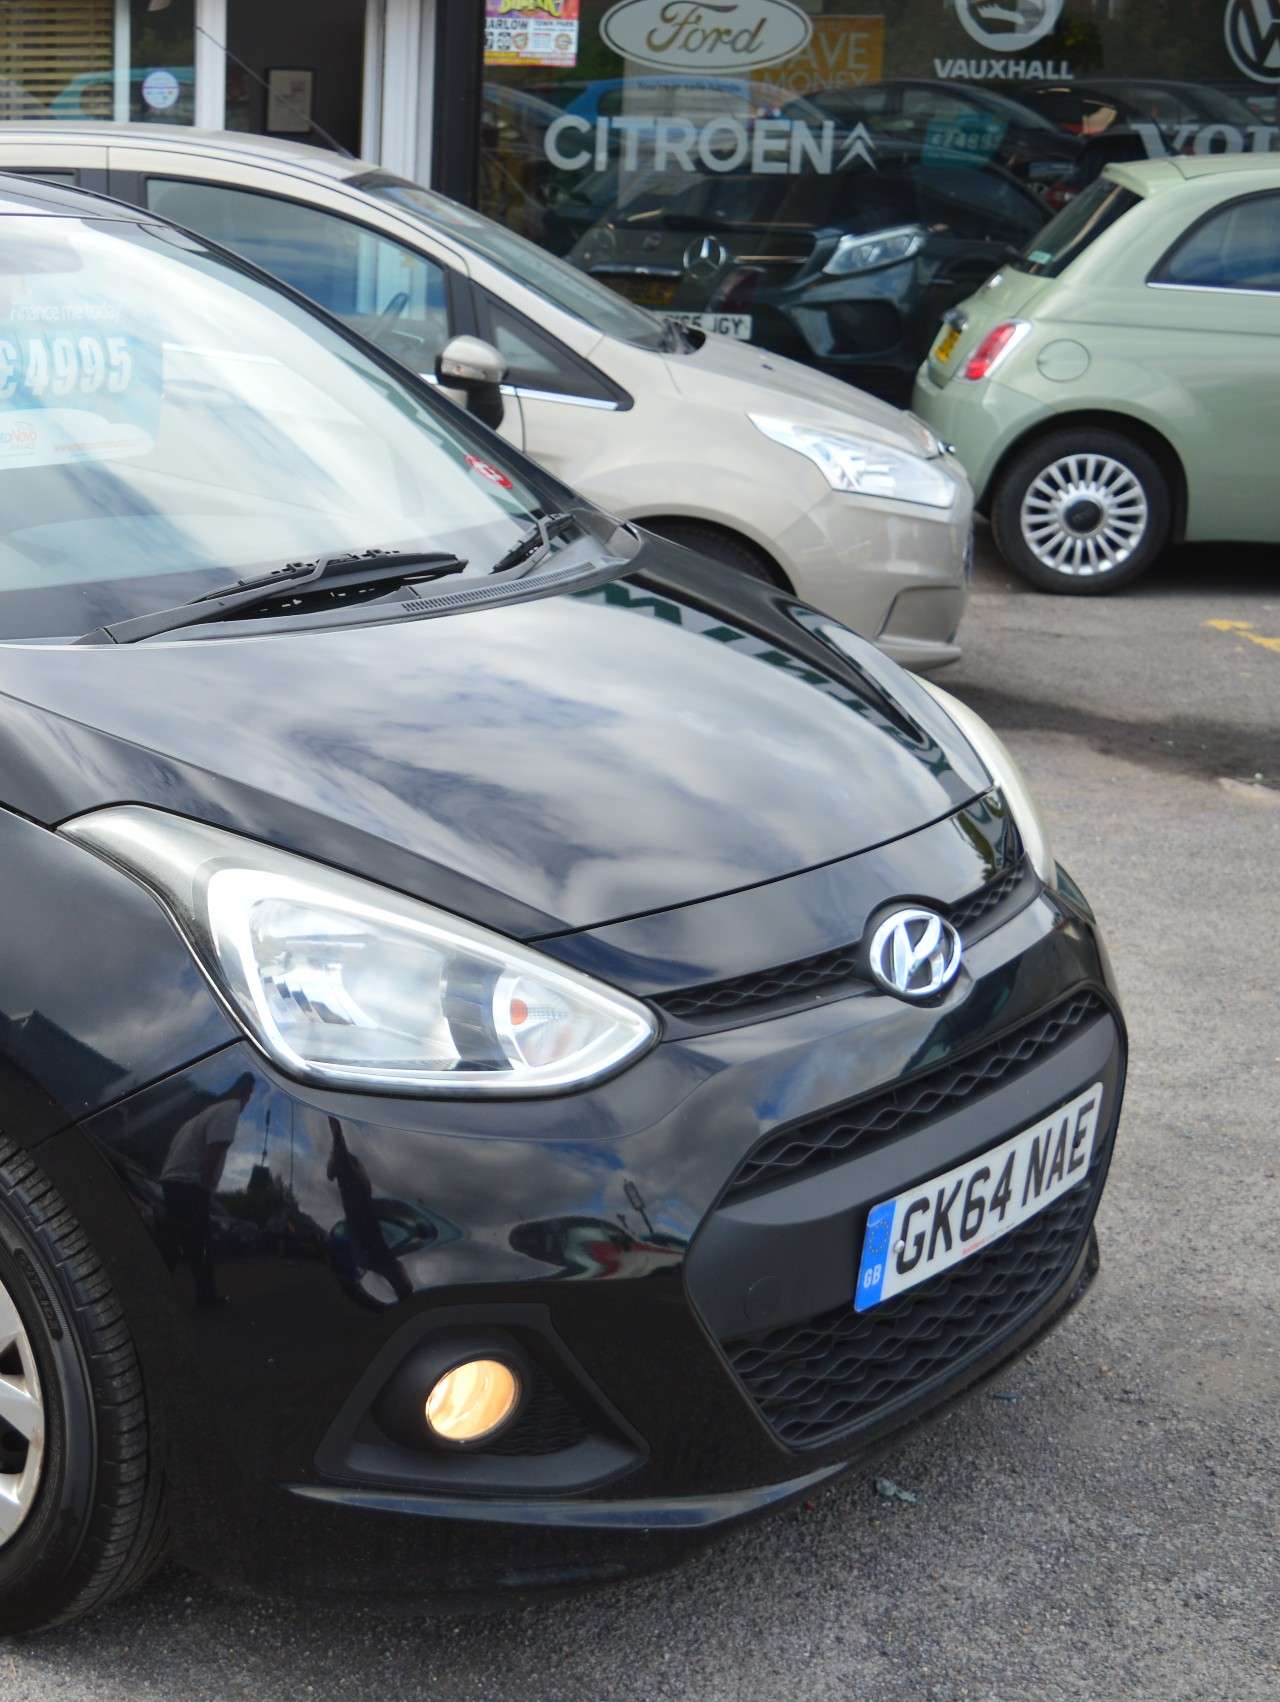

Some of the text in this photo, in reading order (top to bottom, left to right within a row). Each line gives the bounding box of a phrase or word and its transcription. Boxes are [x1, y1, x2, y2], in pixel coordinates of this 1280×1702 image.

[484, 19, 528, 30] ARLOW
[645, 0, 768, 54] Ford
[770, 30, 871, 70] AVE
[933, 58, 1074, 80] VAUXHALL
[895, 1099, 1095, 1275] GK64 NAE
[863, 1264, 882, 1289] GB
